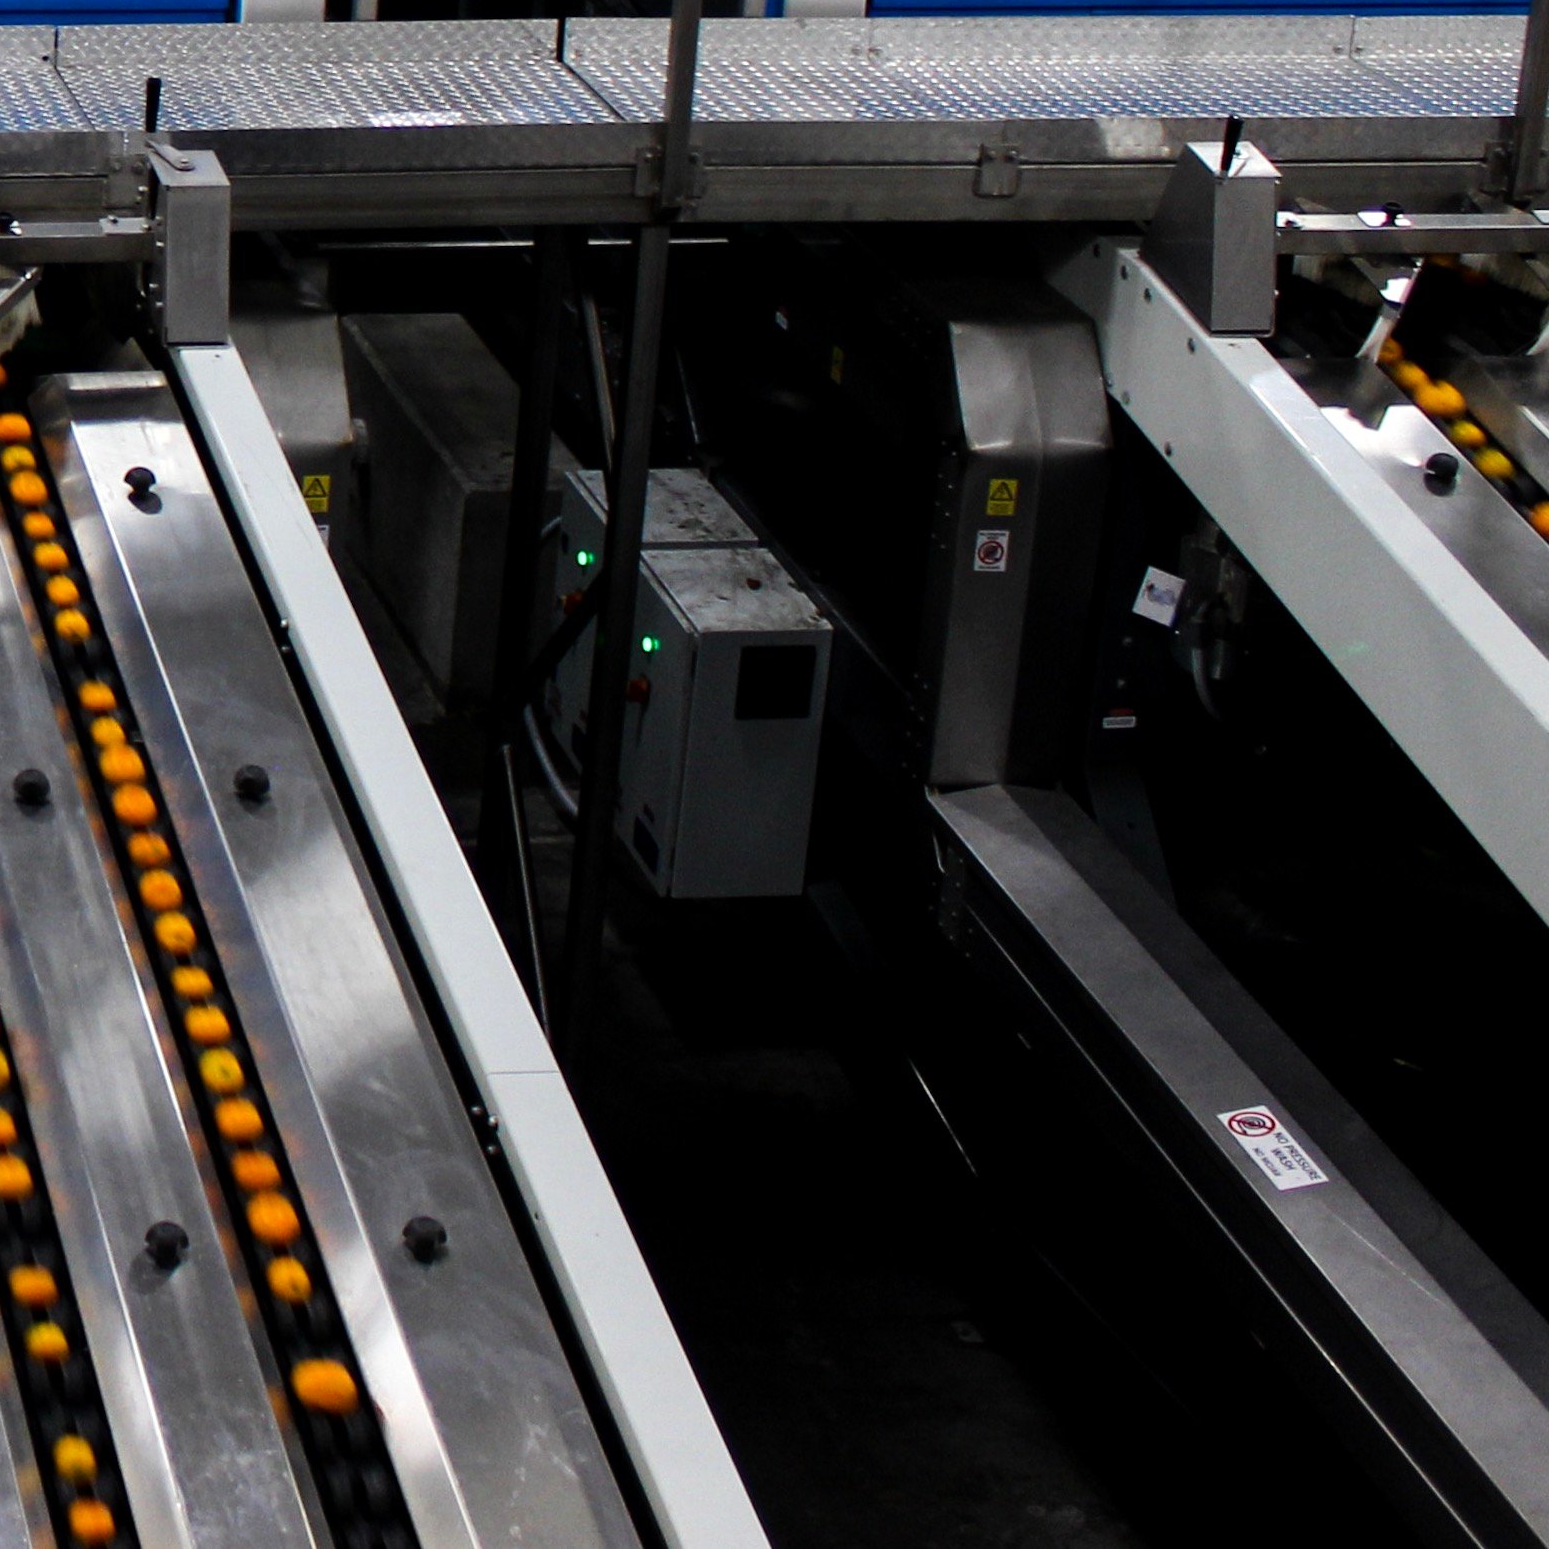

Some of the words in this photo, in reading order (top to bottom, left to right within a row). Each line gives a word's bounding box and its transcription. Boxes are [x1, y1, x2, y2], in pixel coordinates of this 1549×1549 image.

[1271, 1148, 1297, 1170] WASH
[1273, 1132, 1289, 1144] NO
[1283, 1144, 1322, 1181] PRESSURE
